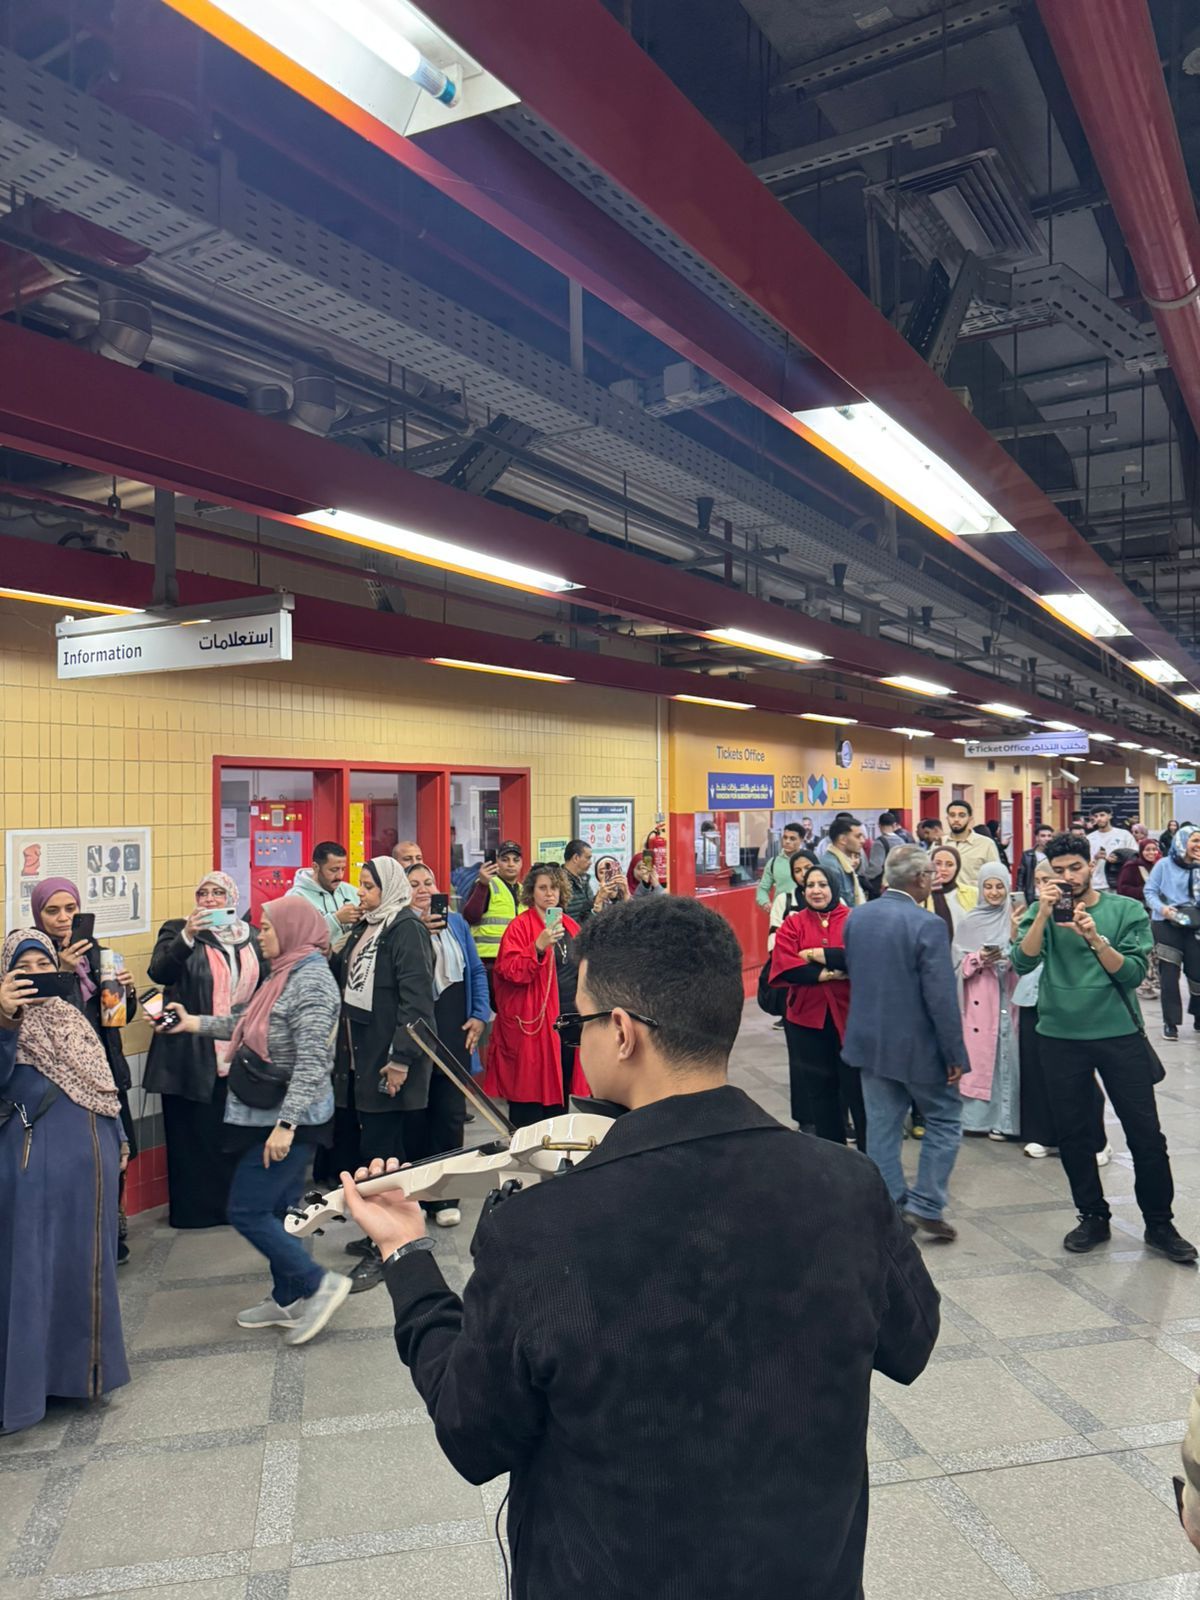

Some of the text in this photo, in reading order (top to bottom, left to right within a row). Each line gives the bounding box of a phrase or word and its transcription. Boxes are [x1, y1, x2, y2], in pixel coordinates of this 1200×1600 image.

[199, 627, 273, 650] إستعلامات
[63, 644, 142, 666] Information
[716, 745, 766, 763] Tickets Office
[975, 744, 1031, 753] Ticket Office
[1031, 743, 1087, 753] مكتب التذاكر
[781, 775, 804, 788] GREEN
[781, 790, 797, 804] LINE
